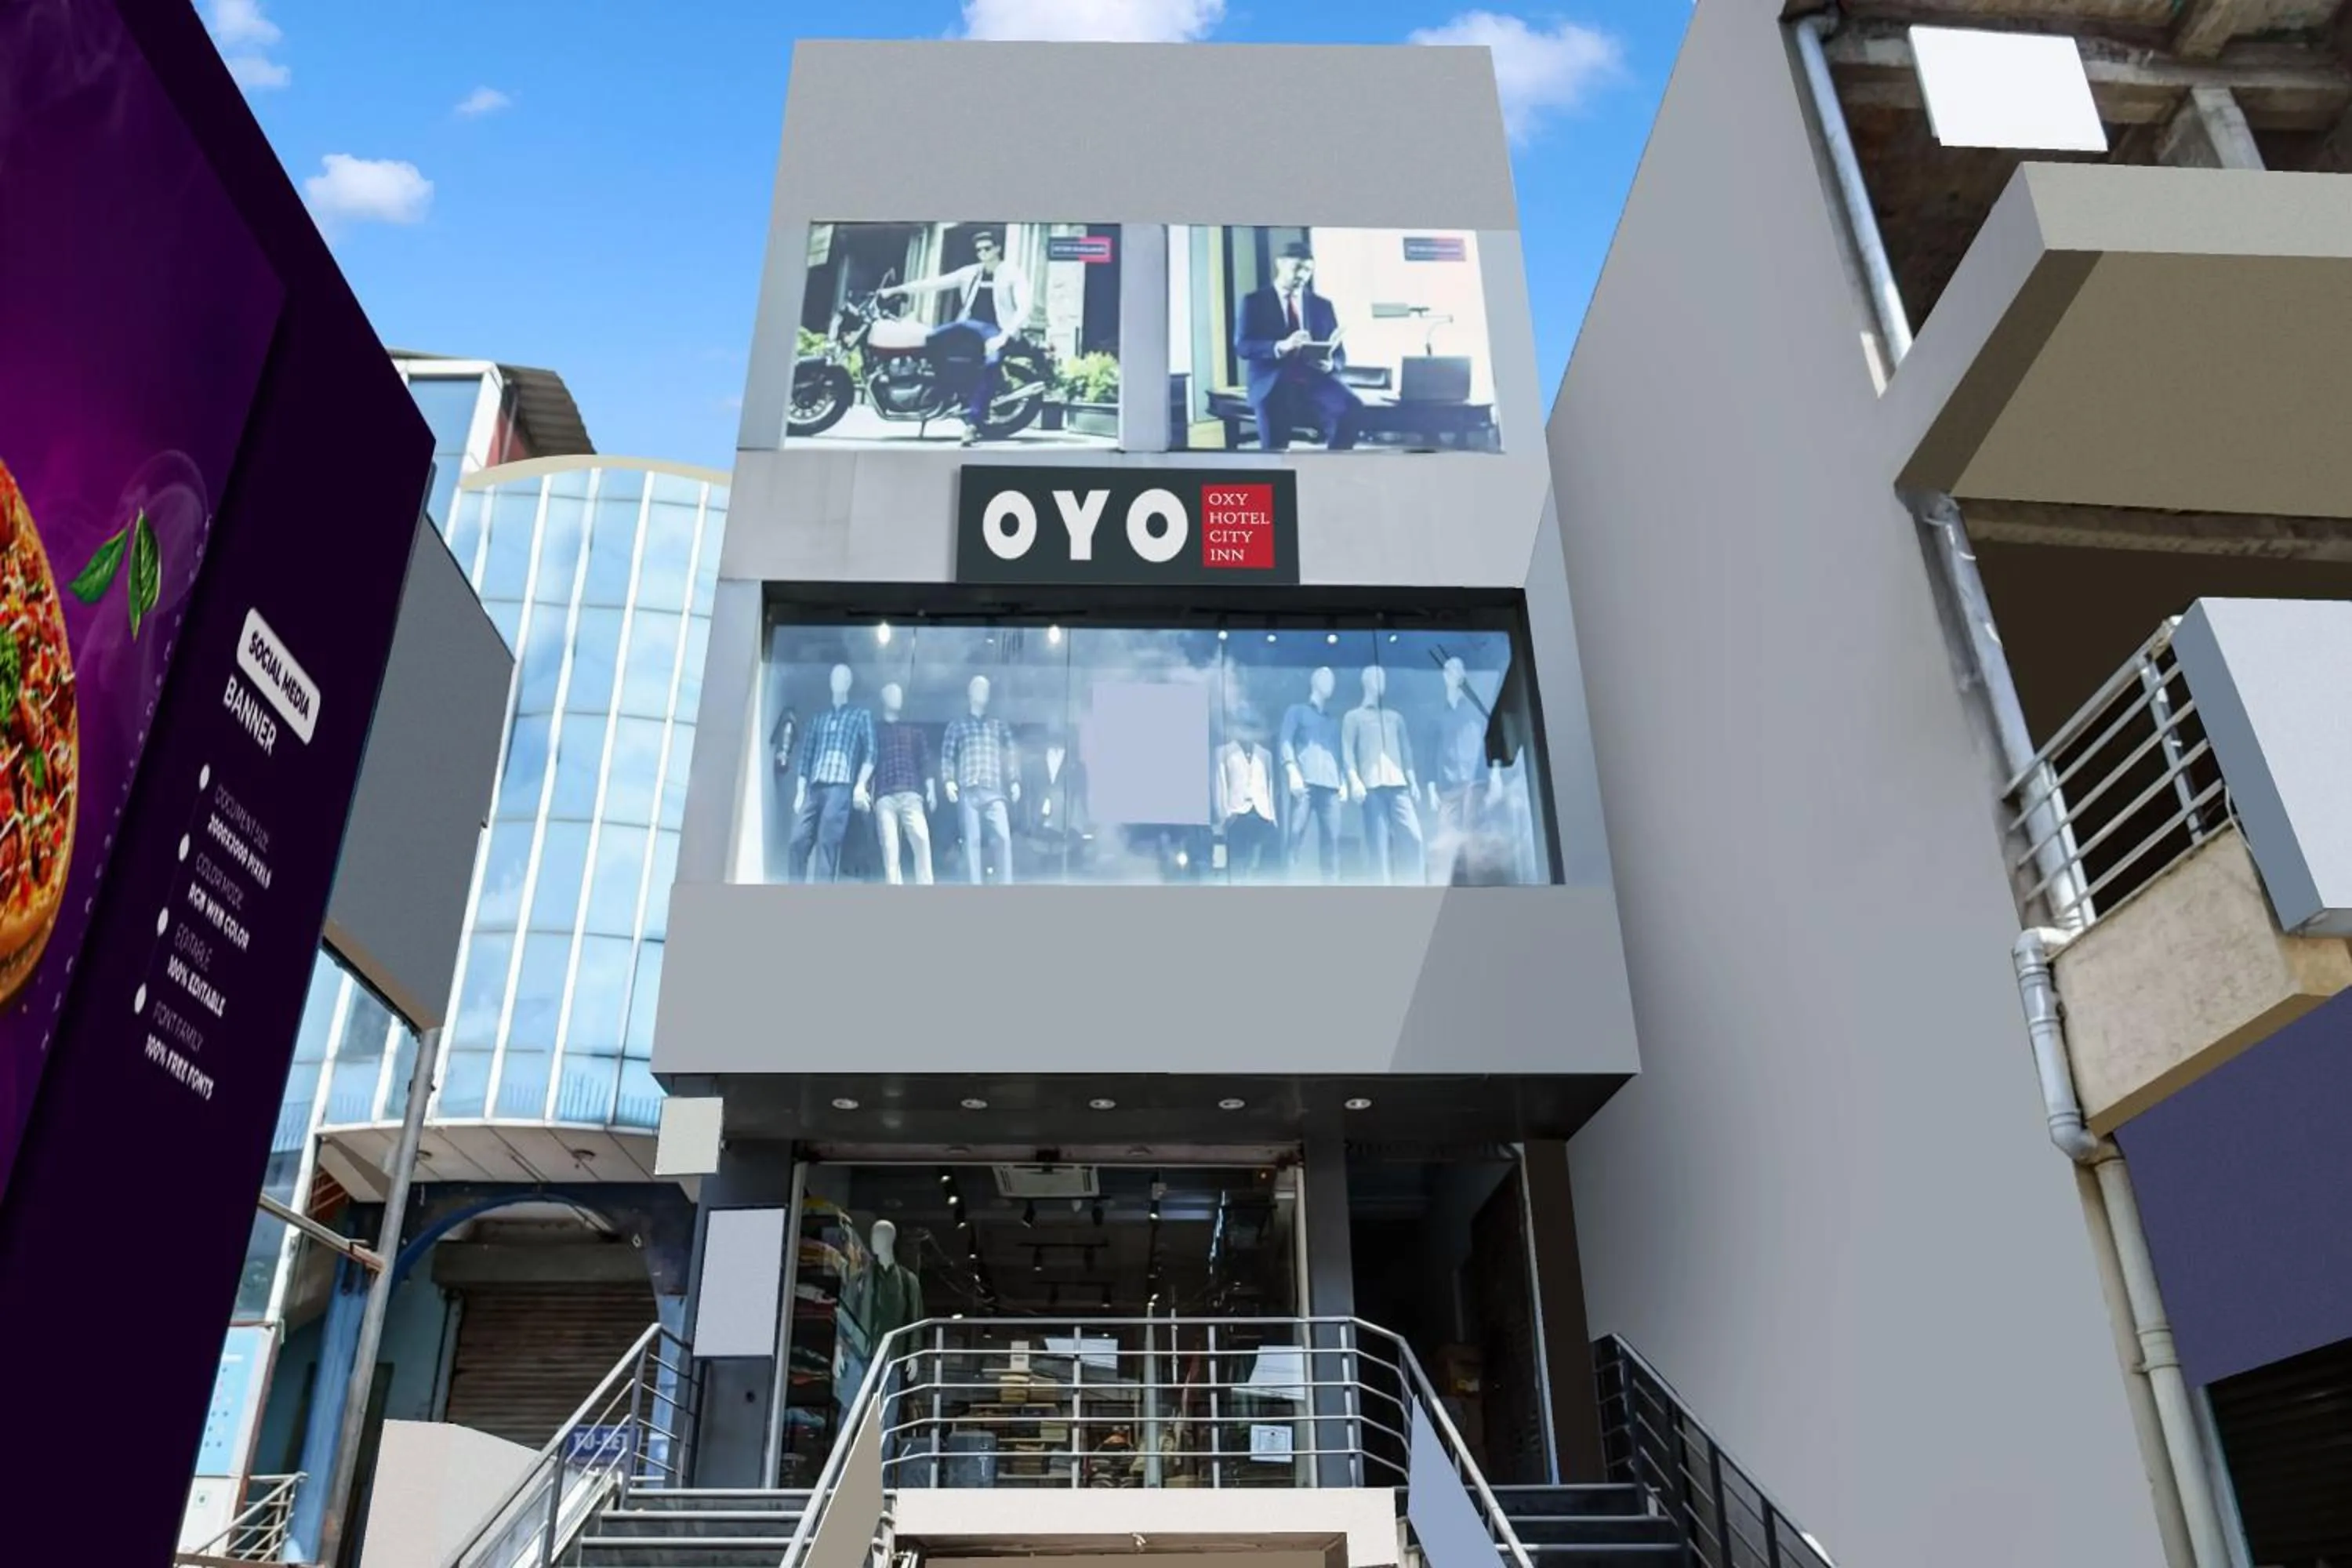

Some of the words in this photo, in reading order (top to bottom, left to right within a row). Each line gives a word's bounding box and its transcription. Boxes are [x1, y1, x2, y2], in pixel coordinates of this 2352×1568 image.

[1209, 492, 1248, 506] OXY
[1210, 512, 1270, 524] HOTEL
[982, 488, 1189, 562] OYO
[1210, 530, 1253, 543] CITY
[1210, 549, 1244, 561] INN
[249, 631, 282, 685] SOCIAL
[281, 670, 309, 720] MEDIA
[223, 674, 276, 756] BANNER
[205, 897, 224, 927] WEB
[224, 916, 249, 950] COLOR
[188, 972, 226, 1017] EDITABLE
[166, 1050, 188, 1082] FREE
[187, 1065, 214, 1100] FONTS
